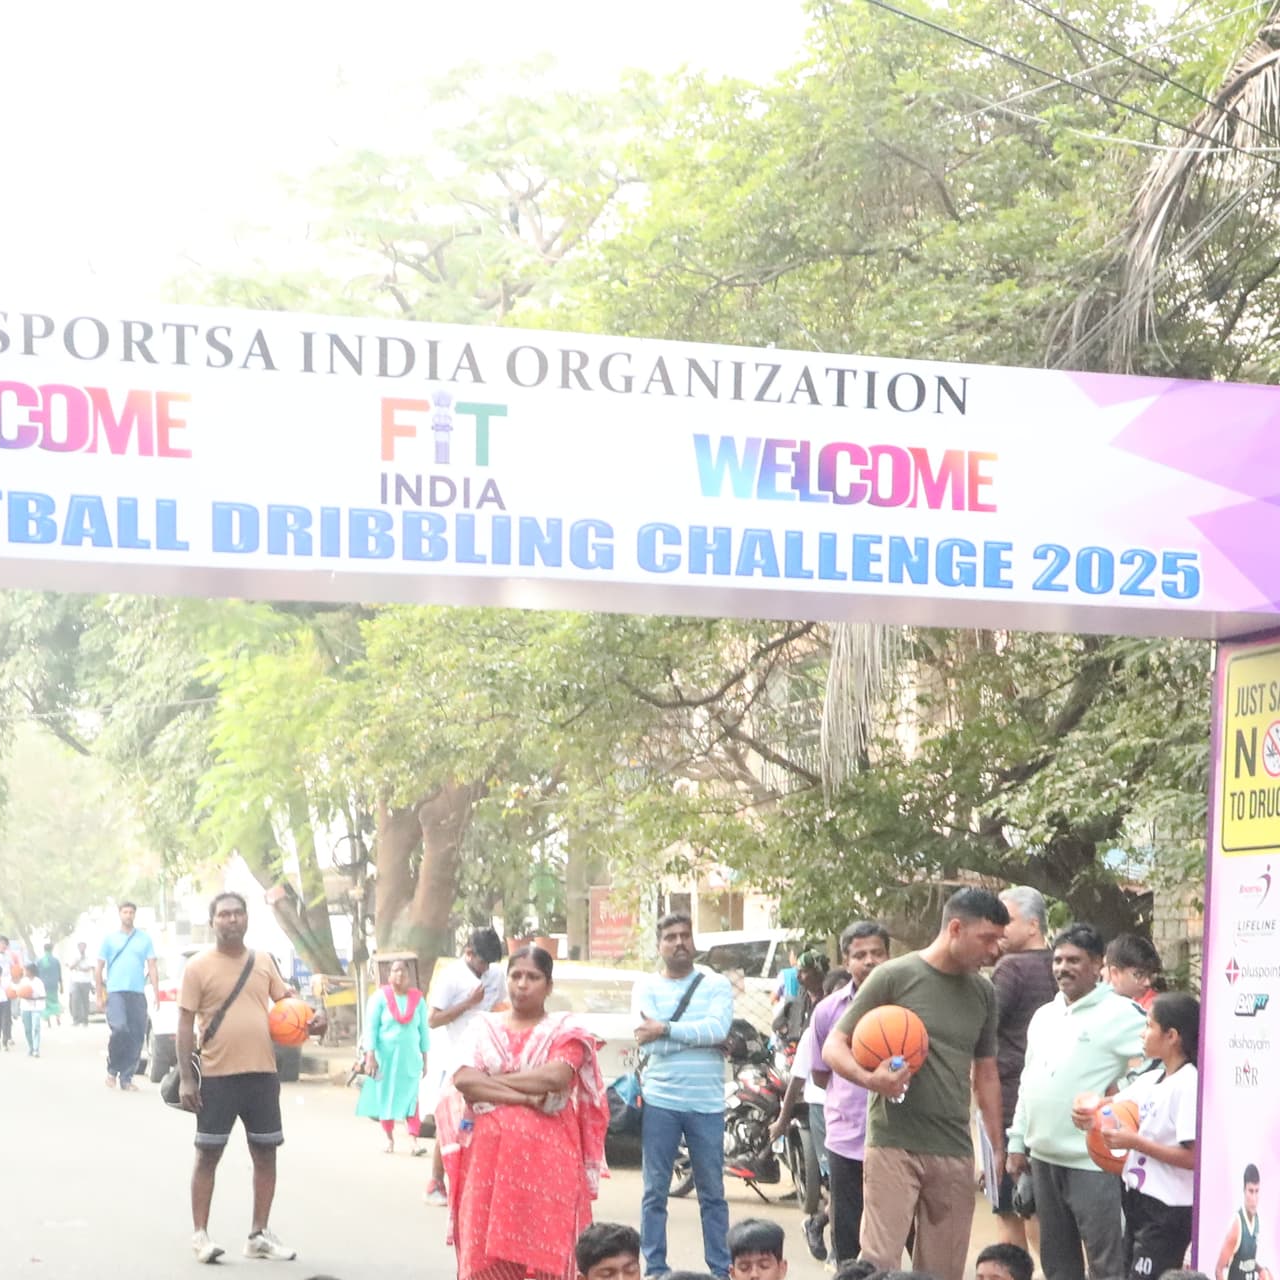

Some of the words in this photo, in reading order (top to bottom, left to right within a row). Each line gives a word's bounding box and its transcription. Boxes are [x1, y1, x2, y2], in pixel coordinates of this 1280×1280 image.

[300, 331, 486, 384] INDIA
[506, 345, 970, 415] ORGANIZATION
[381, 472, 508, 511] INDIA
[693, 434, 998, 512] WELCOME
[212, 501, 614, 571] DRIBBLING
[637, 522, 1013, 589] CHALLENGE
[1033, 544, 1200, 600] 2025
[1234, 684, 1266, 718] JUST
[1230, 791, 1244, 821] TO
[1135, 1257, 1152, 1275] 40
